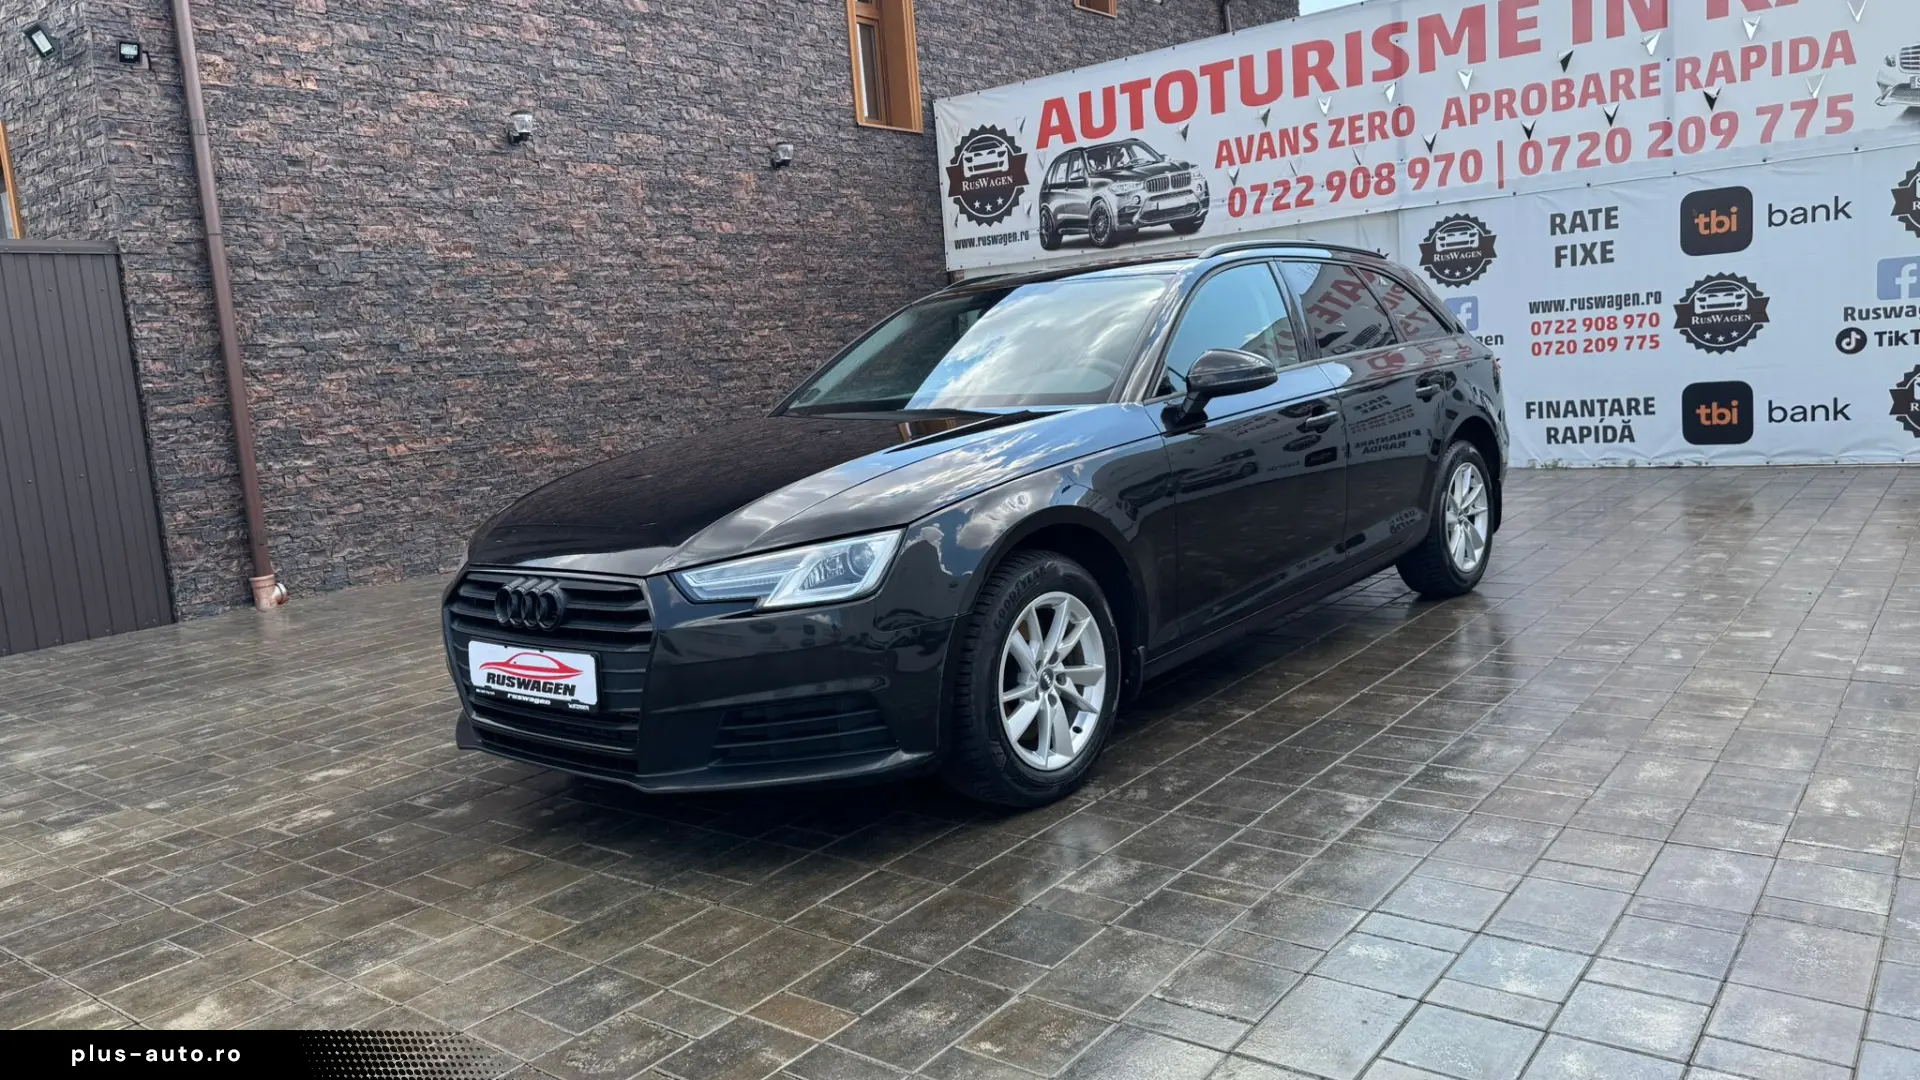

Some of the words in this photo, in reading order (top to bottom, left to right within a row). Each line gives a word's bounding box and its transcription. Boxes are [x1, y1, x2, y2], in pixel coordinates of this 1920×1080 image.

[1036, 0, 1541, 150] AUTOTURISME
[1215, 122, 1319, 169] AVANS
[1329, 106, 1416, 150] ZERO
[1441, 62, 1661, 130] APROBARE
[1675, 29, 1857, 92] RAPIDA
[1228, 175, 1315, 218] 0722
[1326, 162, 1396, 200] 908
[1407, 148, 1483, 191] 970
[1517, 127, 1632, 176] 0720
[1646, 110, 1740, 159] 209
[1756, 93, 1855, 145] 775
[1549, 206, 1620, 236] RATE
[1694, 207, 1738, 236] tbi
[1767, 196, 1853, 228] bank
[954, 230, 1030, 250] www.ruswagen.ro
[1554, 239, 1615, 269] FIXE
[1528, 291, 1662, 315] www.ruswagen.ro
[1843, 304, 1920, 323] Ruswa
[1530, 318, 1577, 336] 0722
[1582, 315, 1618, 333] 908
[1623, 312, 1660, 330] 970
[1531, 339, 1577, 357] 0720
[1583, 336, 1618, 354] 209
[1624, 334, 1660, 351] 775
[1696, 401, 1739, 426] tbi
[1767, 397, 1852, 424] bank
[1546, 419, 1635, 444] RAPIDĂ
[486, 672, 576, 697] RUSWAGEN
[507, 693, 551, 705] ruswagen
